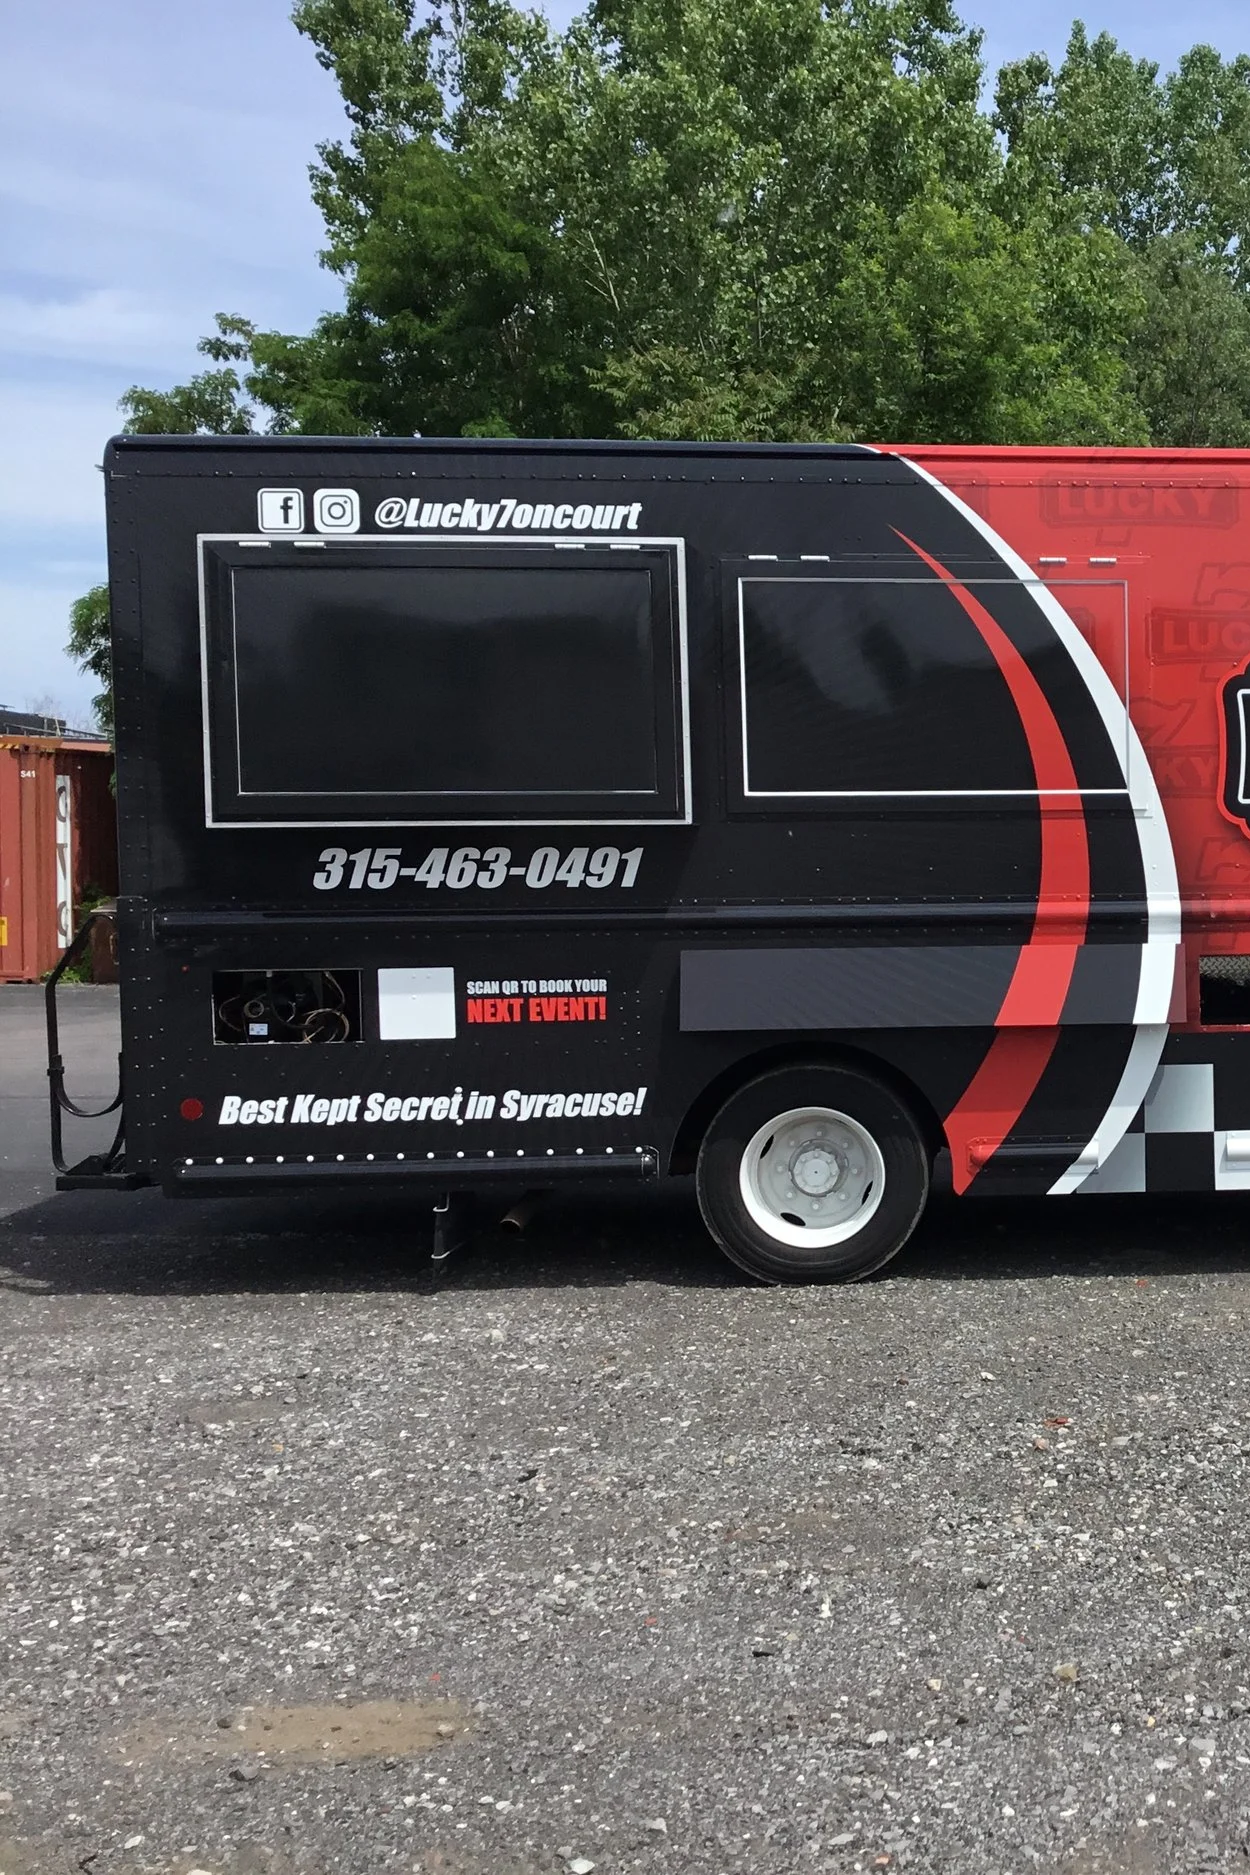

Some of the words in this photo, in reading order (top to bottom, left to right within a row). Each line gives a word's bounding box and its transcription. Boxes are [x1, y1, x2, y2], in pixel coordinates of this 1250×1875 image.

[375, 497, 642, 531] @Lucky7oncourt
[1058, 487, 1218, 517] LUCKY
[312, 846, 644, 890] 315-463-0491
[467, 981, 500, 995] SCAN
[502, 980, 519, 995] QR
[521, 980, 537, 993] TO
[539, 980, 574, 993] BOOK
[575, 979, 607, 993] YOUR
[467, 997, 524, 1023] NEXT
[529, 996, 607, 1022] EVENT!
[218, 1095, 288, 1125] Best
[290, 1093, 361, 1126] Kept
[363, 1091, 461, 1123] Secret
[464, 1091, 496, 1120] in
[500, 1087, 648, 1122] Syracuse!
